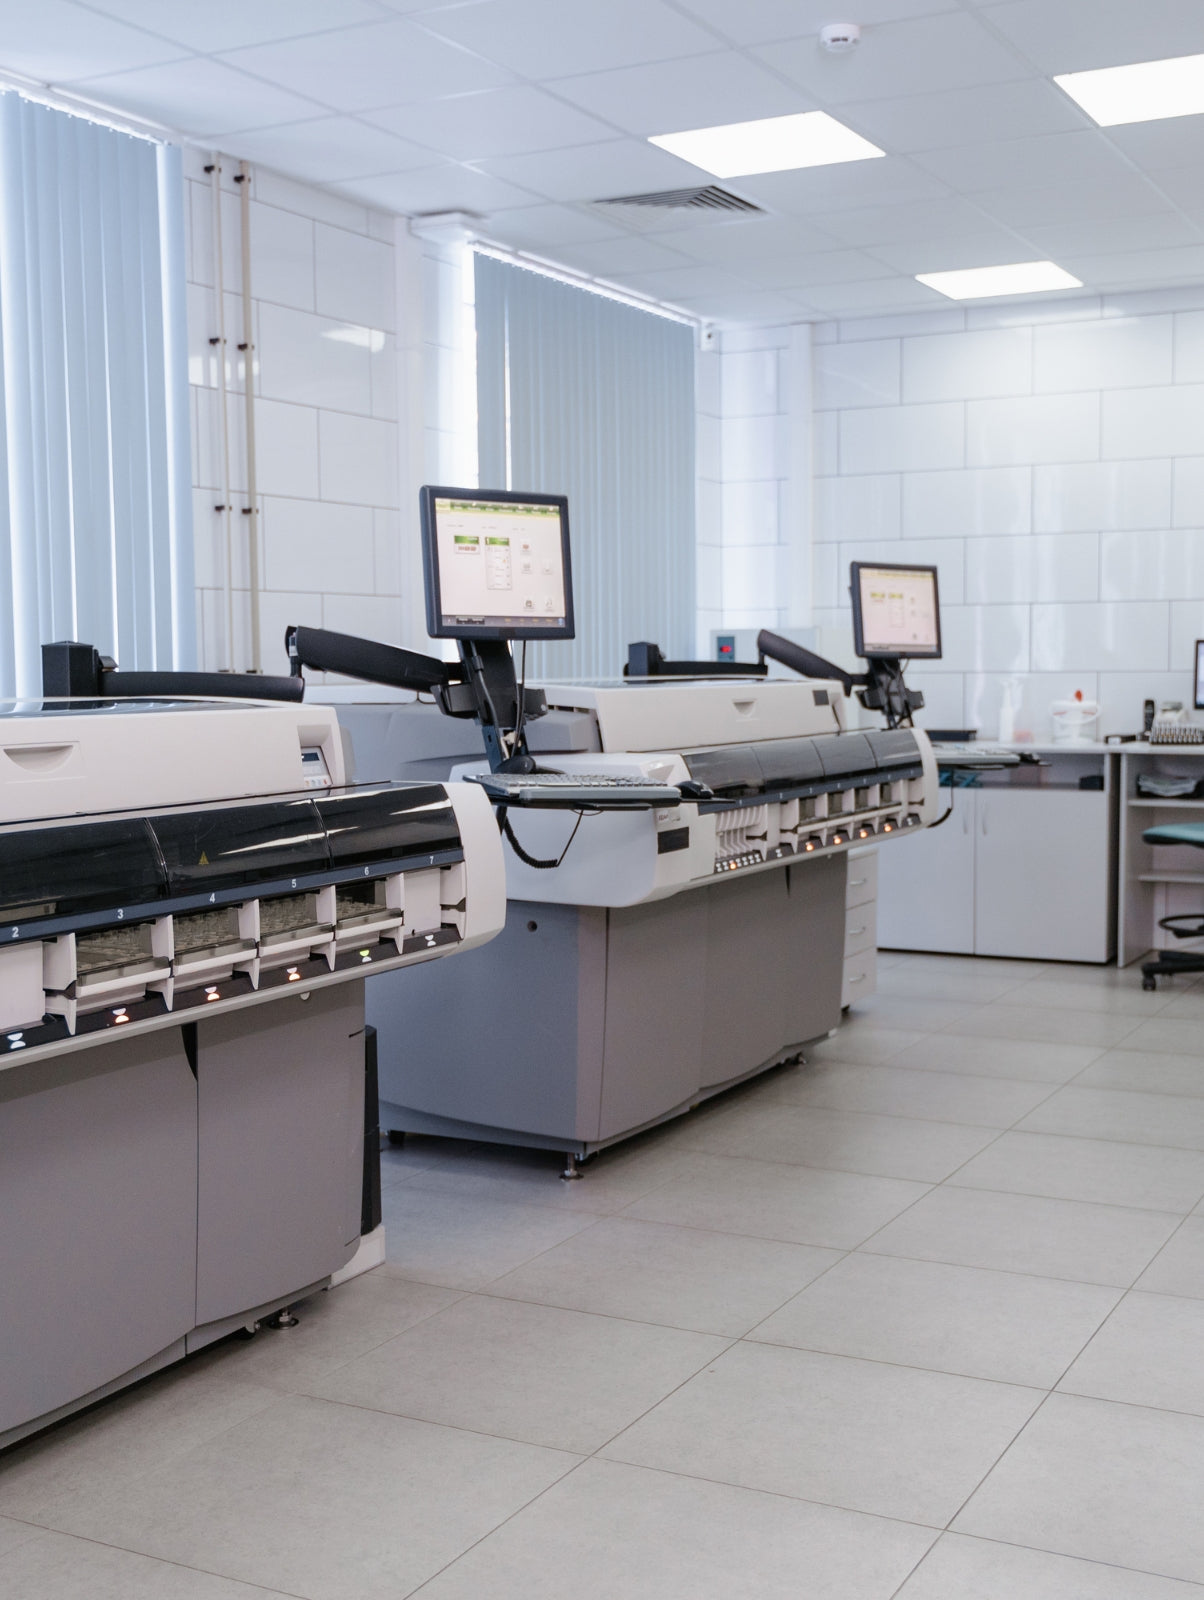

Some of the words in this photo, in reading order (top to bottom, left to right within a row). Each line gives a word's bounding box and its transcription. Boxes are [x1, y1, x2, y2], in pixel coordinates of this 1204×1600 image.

[12, 927, 19, 938] 2
[117, 909, 124, 919] 3
[209, 892, 215, 903] 4
[291, 879, 297, 889] 5
[364, 867, 369, 876] 6
[429, 856, 434, 865] 7
